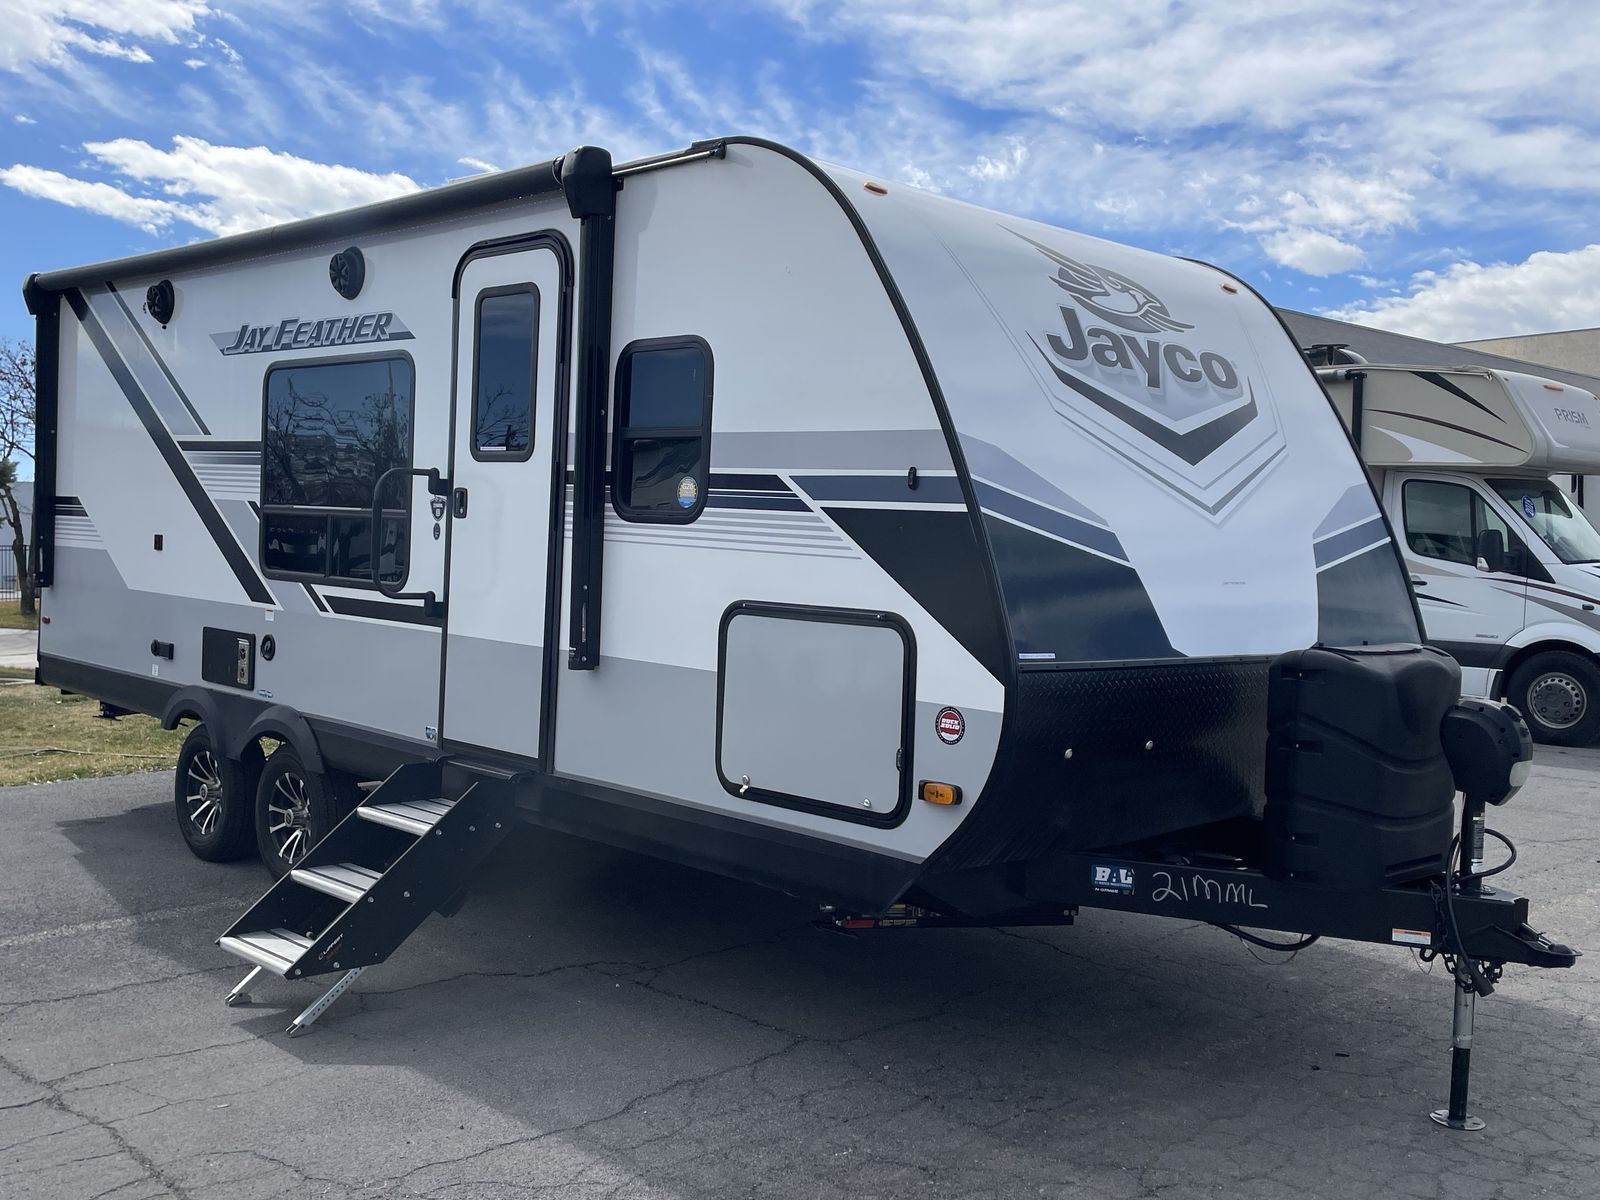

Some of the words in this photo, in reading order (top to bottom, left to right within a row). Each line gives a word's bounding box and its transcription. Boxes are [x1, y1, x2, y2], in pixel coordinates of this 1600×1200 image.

[224, 323, 274, 353] JAY
[273, 311, 394, 350] FEATHER
[1045, 304, 1239, 390] Jayco
[1553, 407, 1589, 425] PRISM
